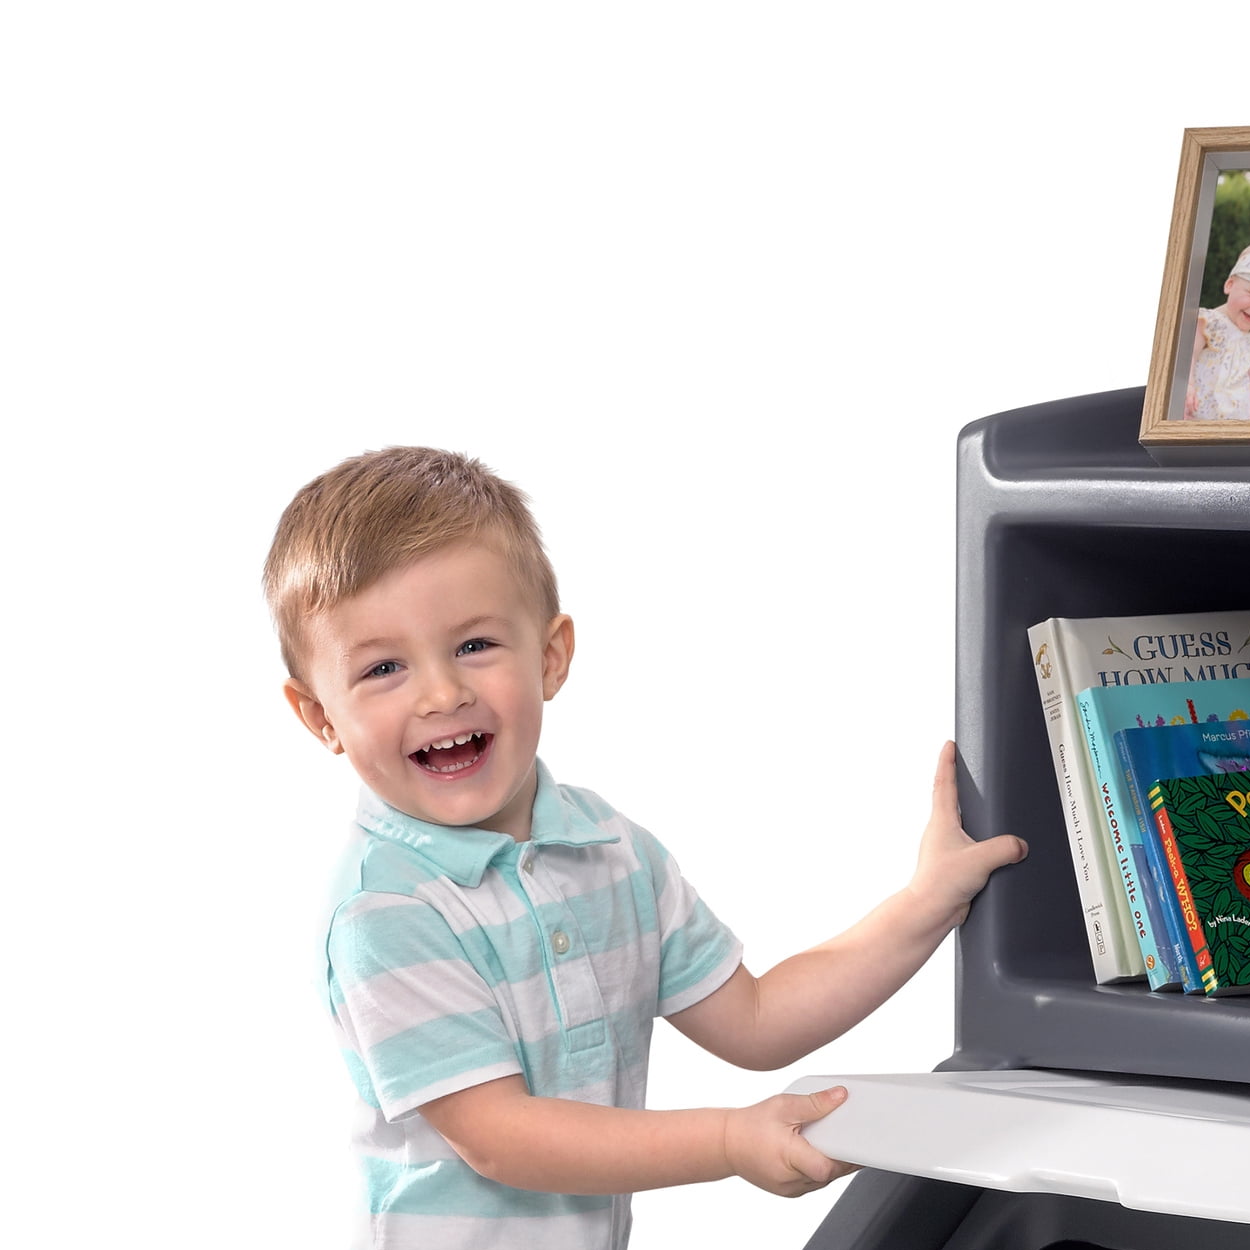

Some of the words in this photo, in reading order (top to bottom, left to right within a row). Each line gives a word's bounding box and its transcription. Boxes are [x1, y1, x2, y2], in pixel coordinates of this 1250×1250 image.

[1133, 631, 1232, 660] GUESS
[1202, 731, 1236, 742] Marcus
[1059, 743, 1067, 773] Guess
[1065, 775, 1073, 798] How
[1070, 800, 1080, 828] Much
[1078, 837, 1086, 861] Love
[1083, 863, 1091, 882] You
[1101, 782, 1124, 854] welcome
[1121, 857, 1136, 904] little
[1134, 910, 1147, 938] one
[1164, 837, 1181, 879] Peek-a
[1176, 879, 1198, 931] WHO?
[1207, 919, 1218, 928] by
[1216, 914, 1231, 925] Nina
